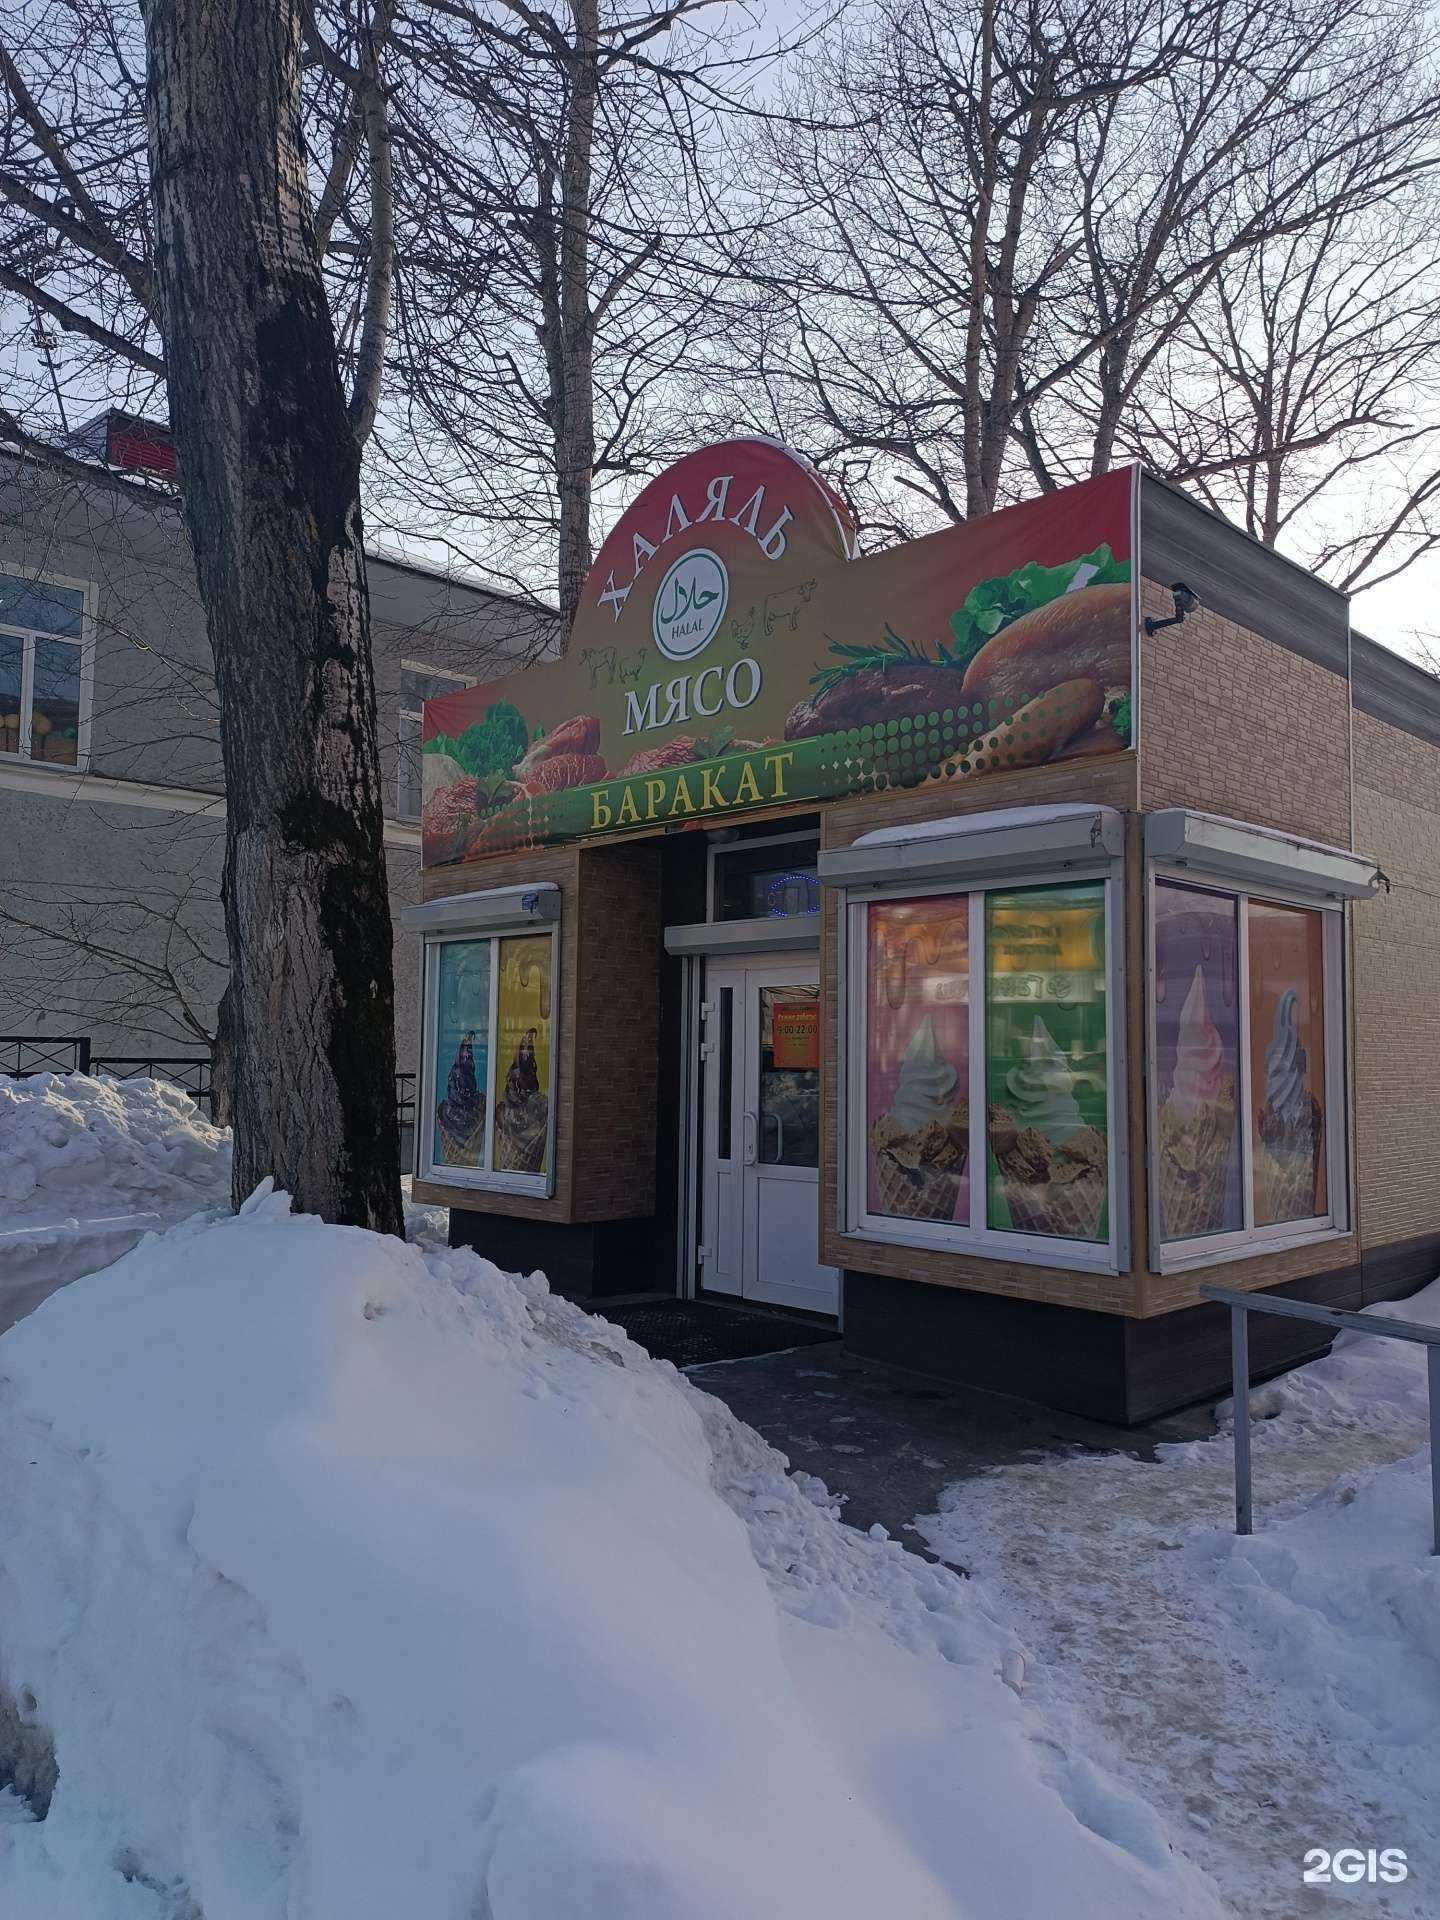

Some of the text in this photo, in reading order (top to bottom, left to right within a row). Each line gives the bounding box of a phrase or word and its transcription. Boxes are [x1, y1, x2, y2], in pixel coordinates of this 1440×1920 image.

[596, 475, 795, 623] ХАЛЯЛЬ
[660, 576, 720, 625] حلال
[671, 620, 705, 640] HALAL
[621, 658, 763, 736] МЯСО
[590, 751, 794, 830] БАРАКАТ
